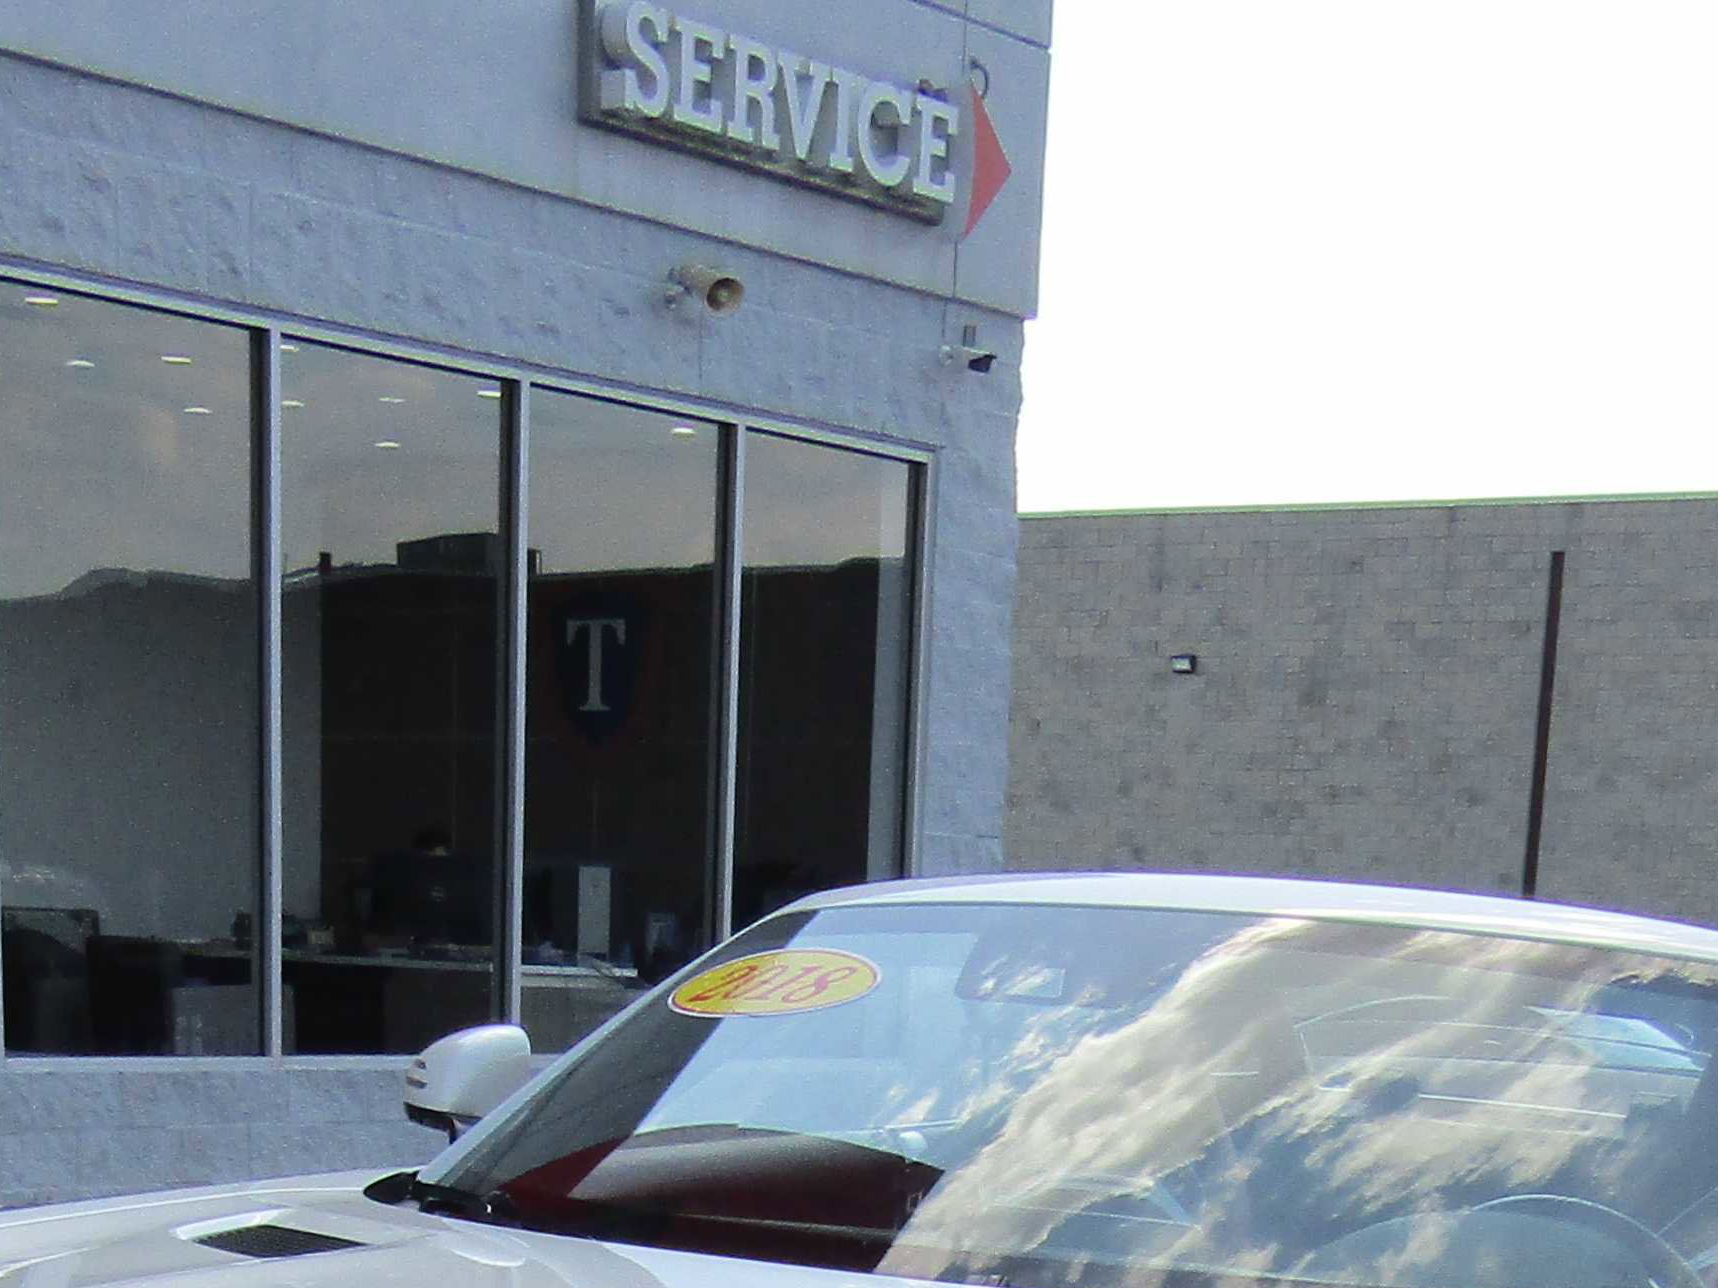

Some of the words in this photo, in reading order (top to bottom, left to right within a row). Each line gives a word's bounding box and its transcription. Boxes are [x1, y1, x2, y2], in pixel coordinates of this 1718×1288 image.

[617, 2, 959, 203] SERVICE
[566, 619, 626, 711] T
[686, 962, 859, 1003] 2018
